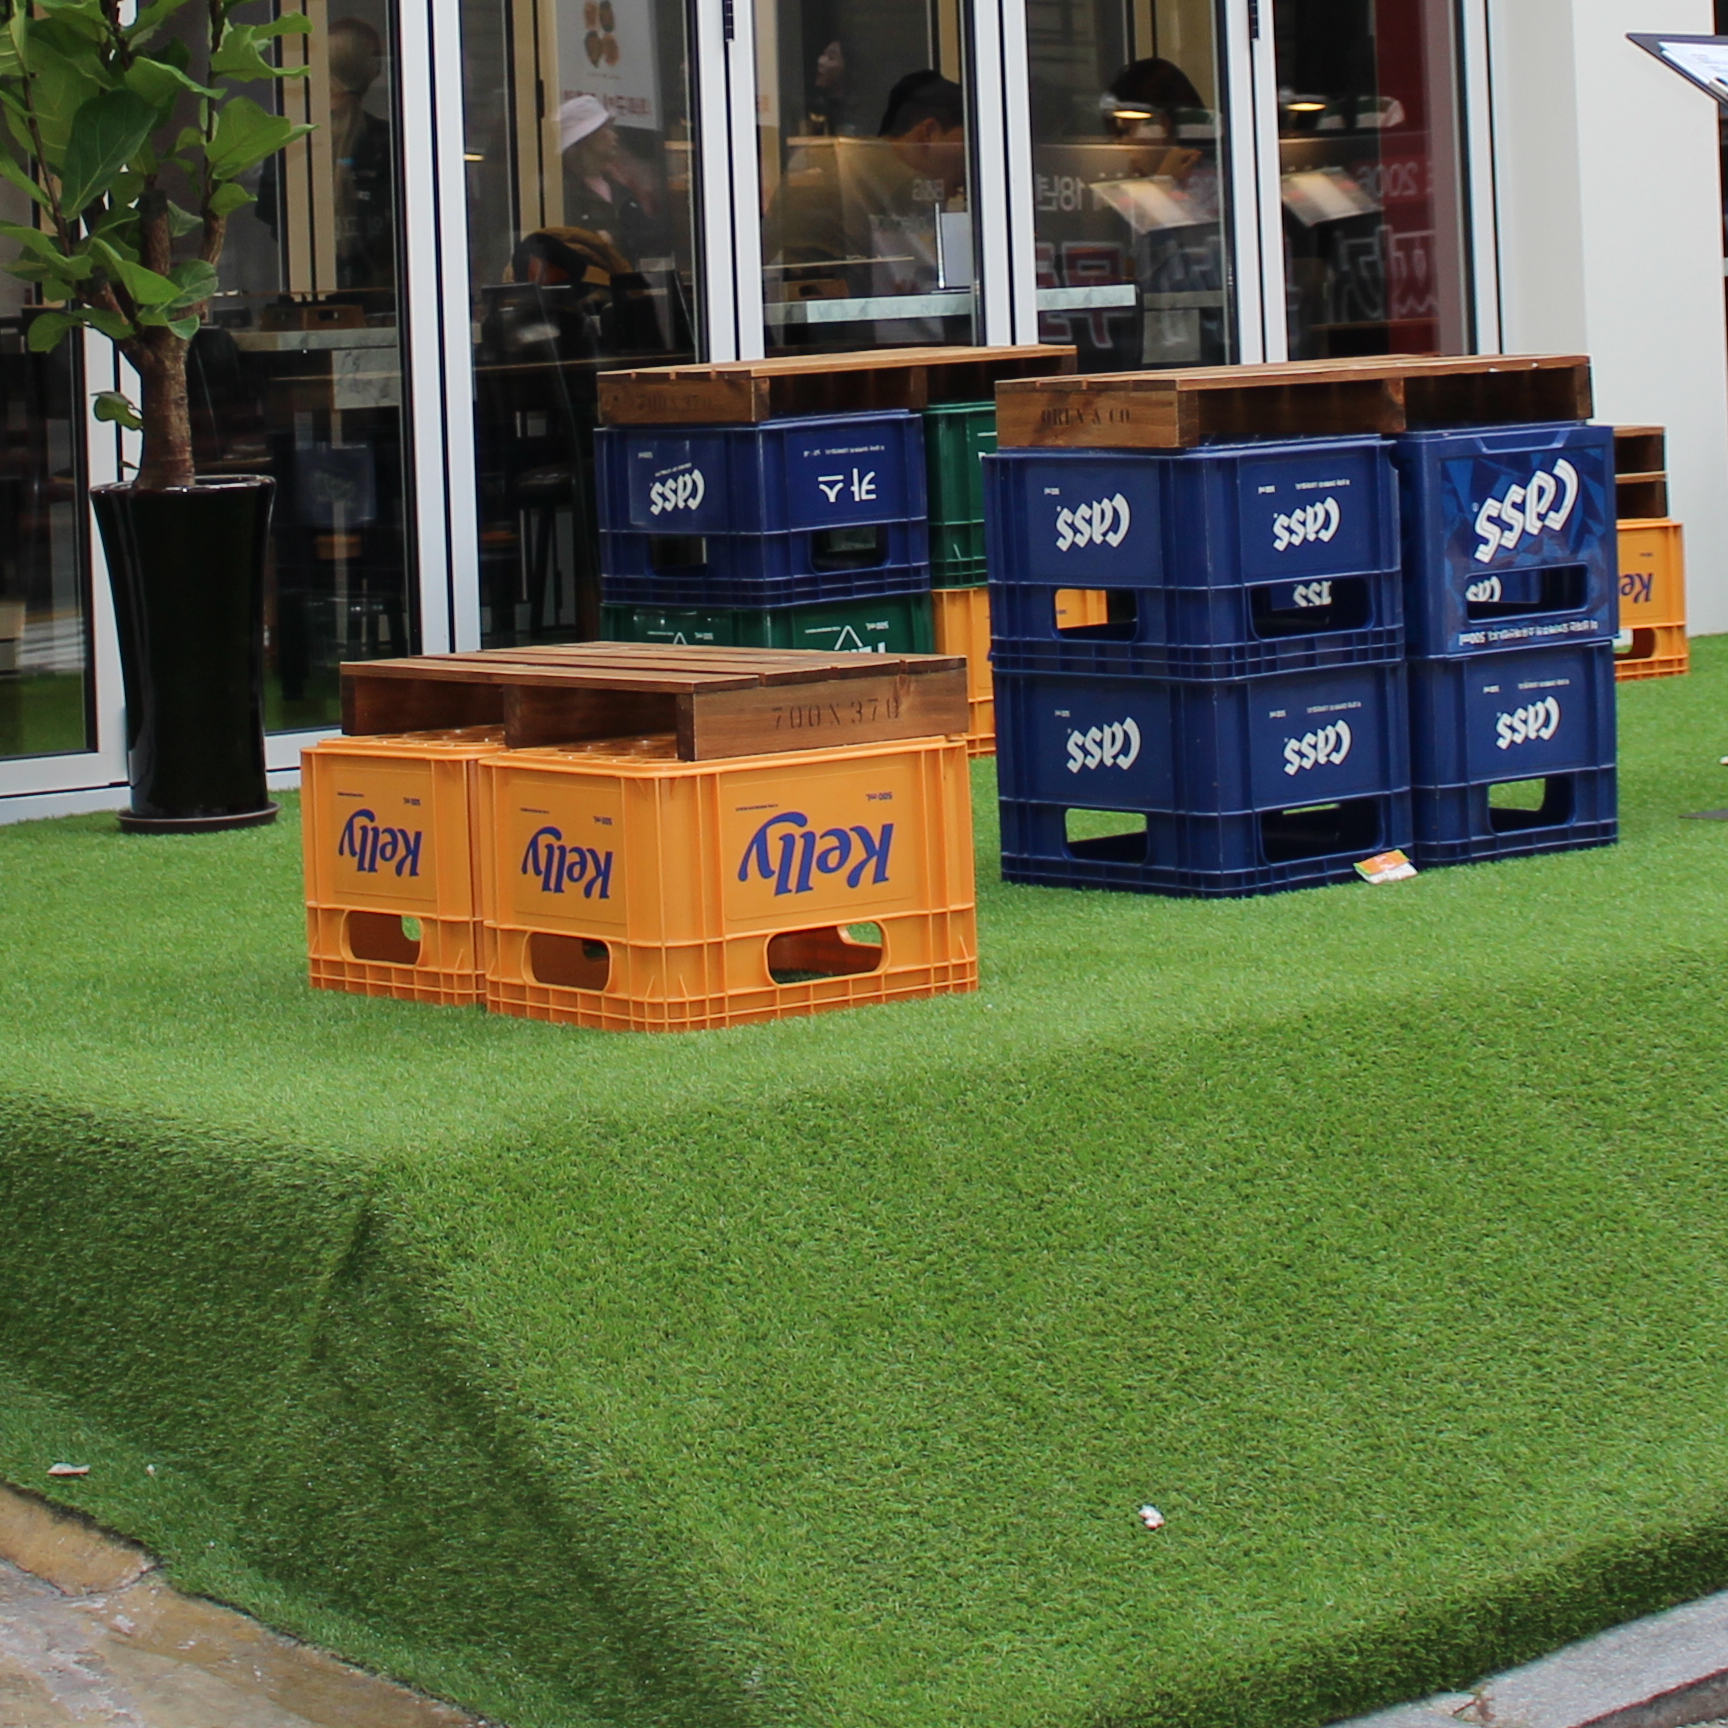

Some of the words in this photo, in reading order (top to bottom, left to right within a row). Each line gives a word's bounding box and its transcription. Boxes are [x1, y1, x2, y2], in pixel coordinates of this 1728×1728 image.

[339, 808, 423, 878] Kelly
[521, 825, 614, 900] Kelly
[738, 811, 895, 897] Kelly
